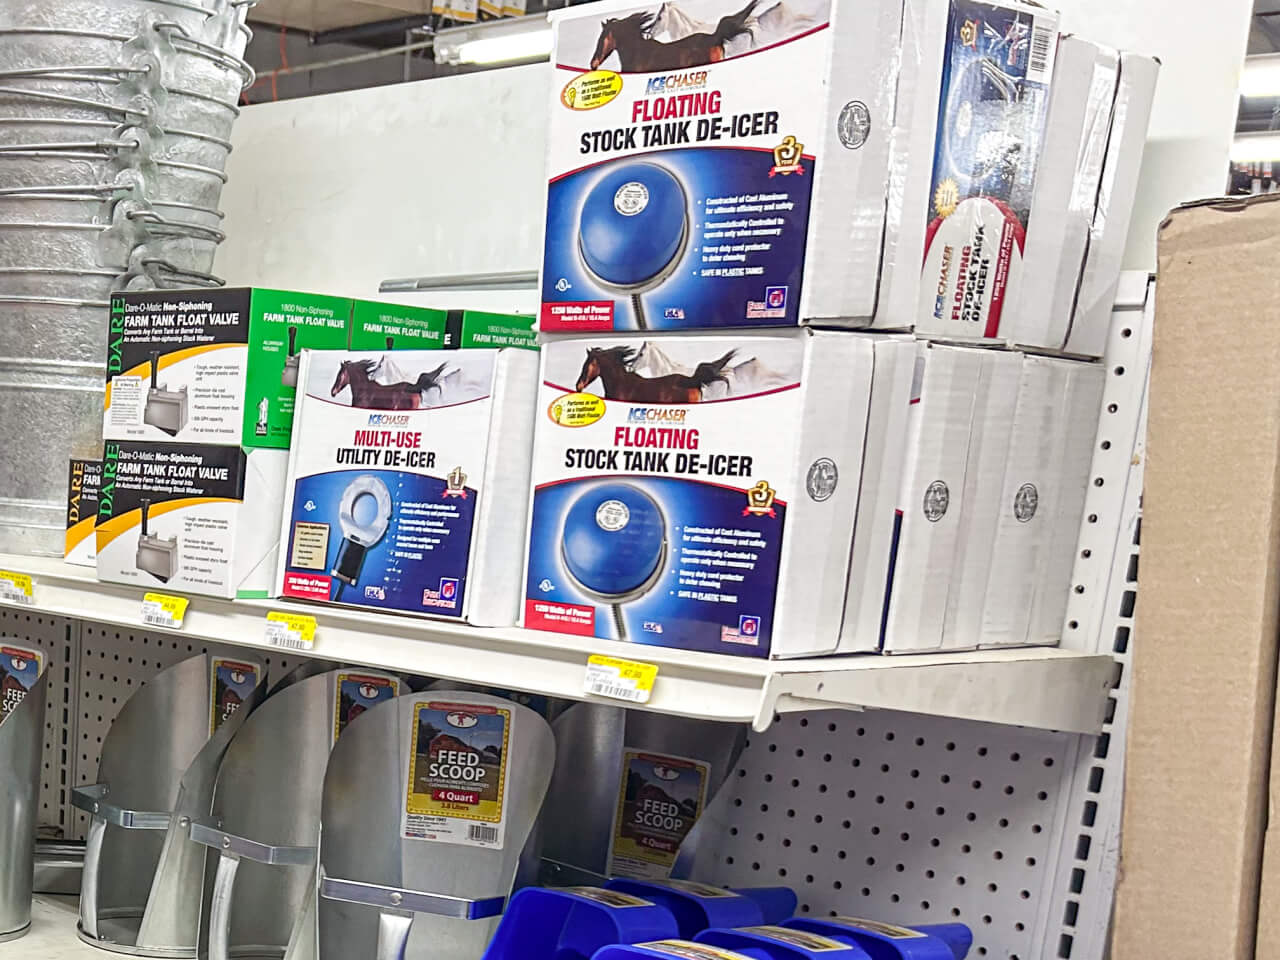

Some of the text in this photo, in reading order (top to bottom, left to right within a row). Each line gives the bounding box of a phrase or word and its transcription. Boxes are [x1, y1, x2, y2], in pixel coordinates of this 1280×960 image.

[646, 70, 709, 92] ICECHASER
[632, 90, 722, 123] FLOATING
[580, 126, 638, 154] STOCK
[642, 120, 691, 148] TANK
[696, 111, 780, 142] DE-ICER
[962, 223, 986, 321] STOCK TANK
[951, 245, 972, 321] FLOATING
[163, 301, 213, 312] Non-Siphoning
[124, 312, 240, 327] FARM TANK FLOAT VALVE
[263, 313, 345, 328] FARM TANK FLOAT VALVE
[109, 298, 125, 372] DARE
[363, 323, 440, 340] FARM TANK FLOAT VALVE
[472, 333, 491, 343] FARM
[492, 335, 508, 344] TANK
[508, 336, 526, 346] FLOAT
[367, 414, 409, 425] ICECHASER
[628, 408, 687, 421] ICECHASER
[353, 430, 422, 449] MULTI-USE
[614, 427, 699, 449] FLOATING
[155, 453, 203, 465] Non-Siphoning
[336, 448, 436, 468] UTILITY DE-ICER
[565, 448, 753, 477] STOCK TANK DE-ICER
[99, 444, 120, 517] DARE
[117, 463, 229, 480] FARM TANK FLOAT VALVE
[69, 463, 84, 523] DARE
[437, 750, 479, 767] FEED
[429, 764, 486, 782] SCOOP
[439, 791, 473, 802] 4 Quart
[643, 799, 678, 817] FEED
[634, 811, 683, 831] SCOOP
